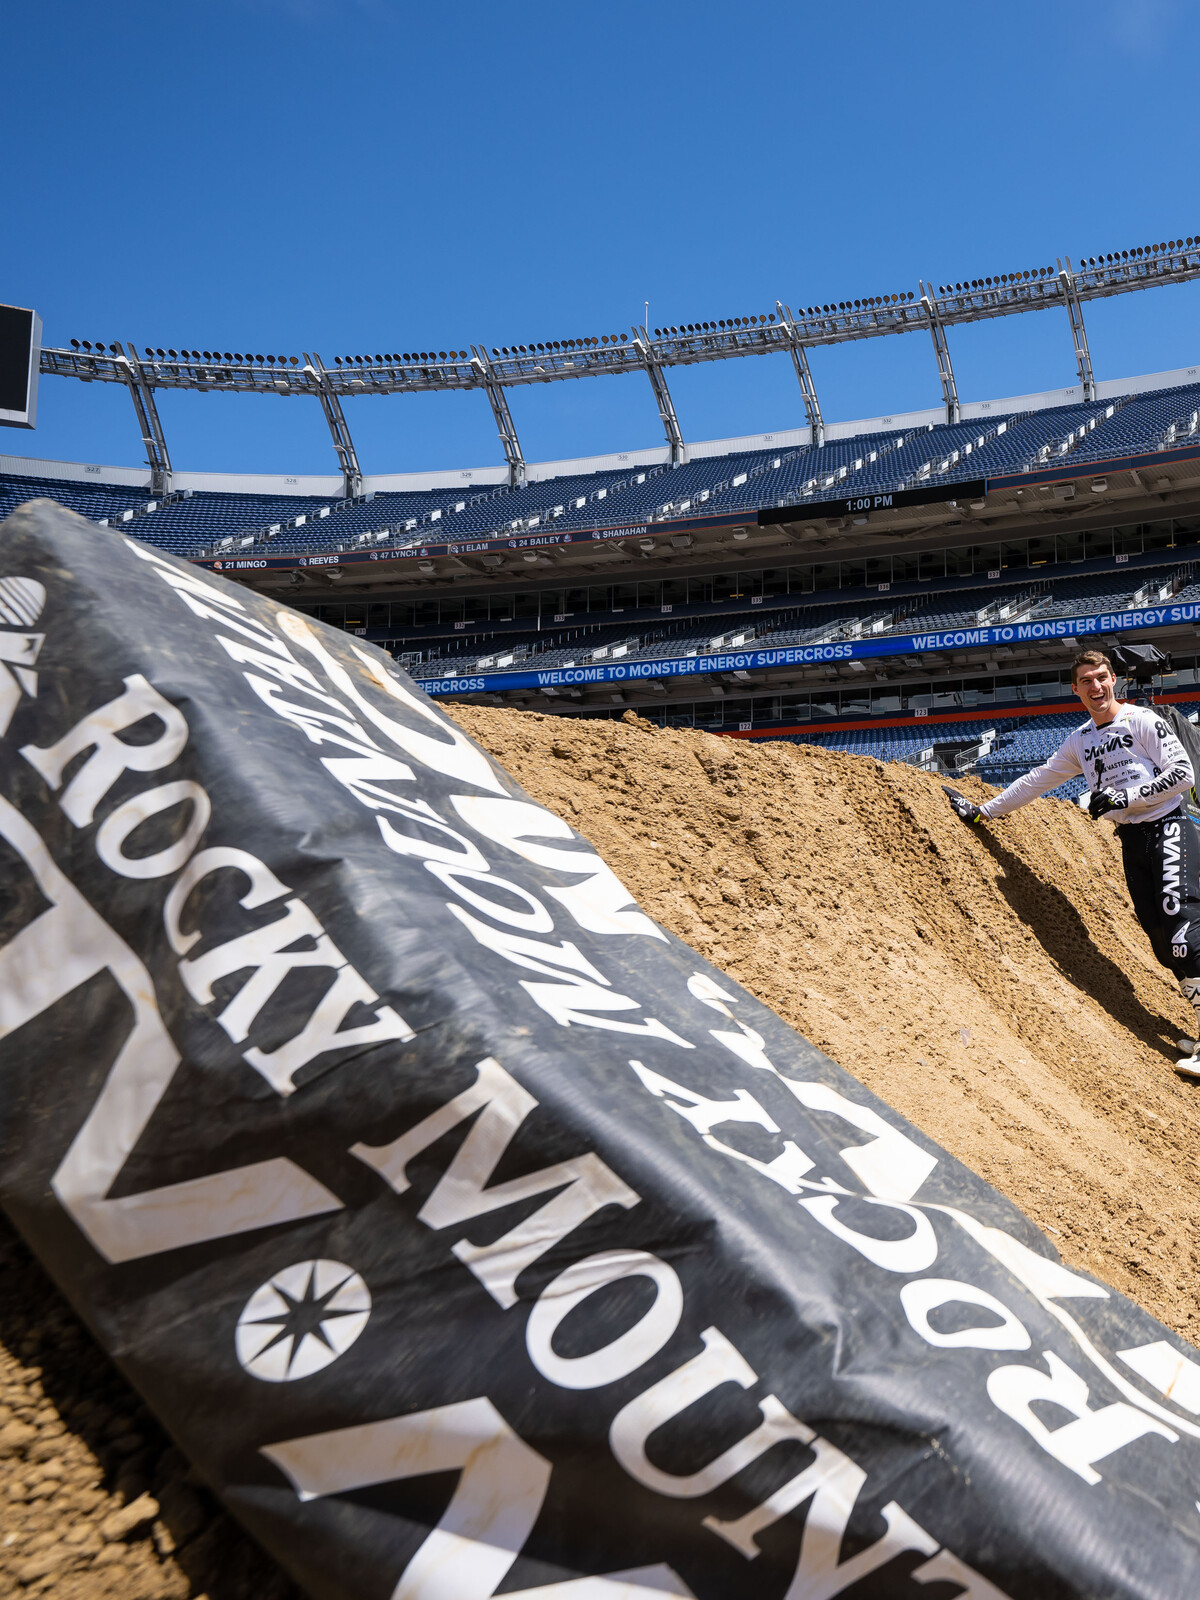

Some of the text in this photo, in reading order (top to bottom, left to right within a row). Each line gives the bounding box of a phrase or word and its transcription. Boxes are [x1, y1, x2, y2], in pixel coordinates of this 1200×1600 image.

[846, 495, 893, 511] 1:00 PM
[602, 526, 647, 538] SHANAHAN
[466, 543, 489, 552] ELAM
[530, 536, 560, 546] BAILEY
[309, 556, 339, 565] REEVES
[391, 550, 417, 559] LYNCH
[236, 560, 267, 569] MINGO
[912, 630, 989, 649] WELCOME
[992, 627, 1014, 641] TO
[1018, 617, 1096, 639] MONSTER
[1101, 609, 1167, 630] ENERGY
[538, 645, 852, 685] WELCOME TO MONSTER ENERGY SUPERCROSS
[1084, 734, 1134, 761] CANVAS
[1140, 767, 1187, 797] CANVAS
[1163, 822, 1181, 916] CANVAS
[19, 673, 416, 1097] ROCKY
[1172, 944, 1188, 958] 80
[628, 1059, 1179, 1485] ROCKY
